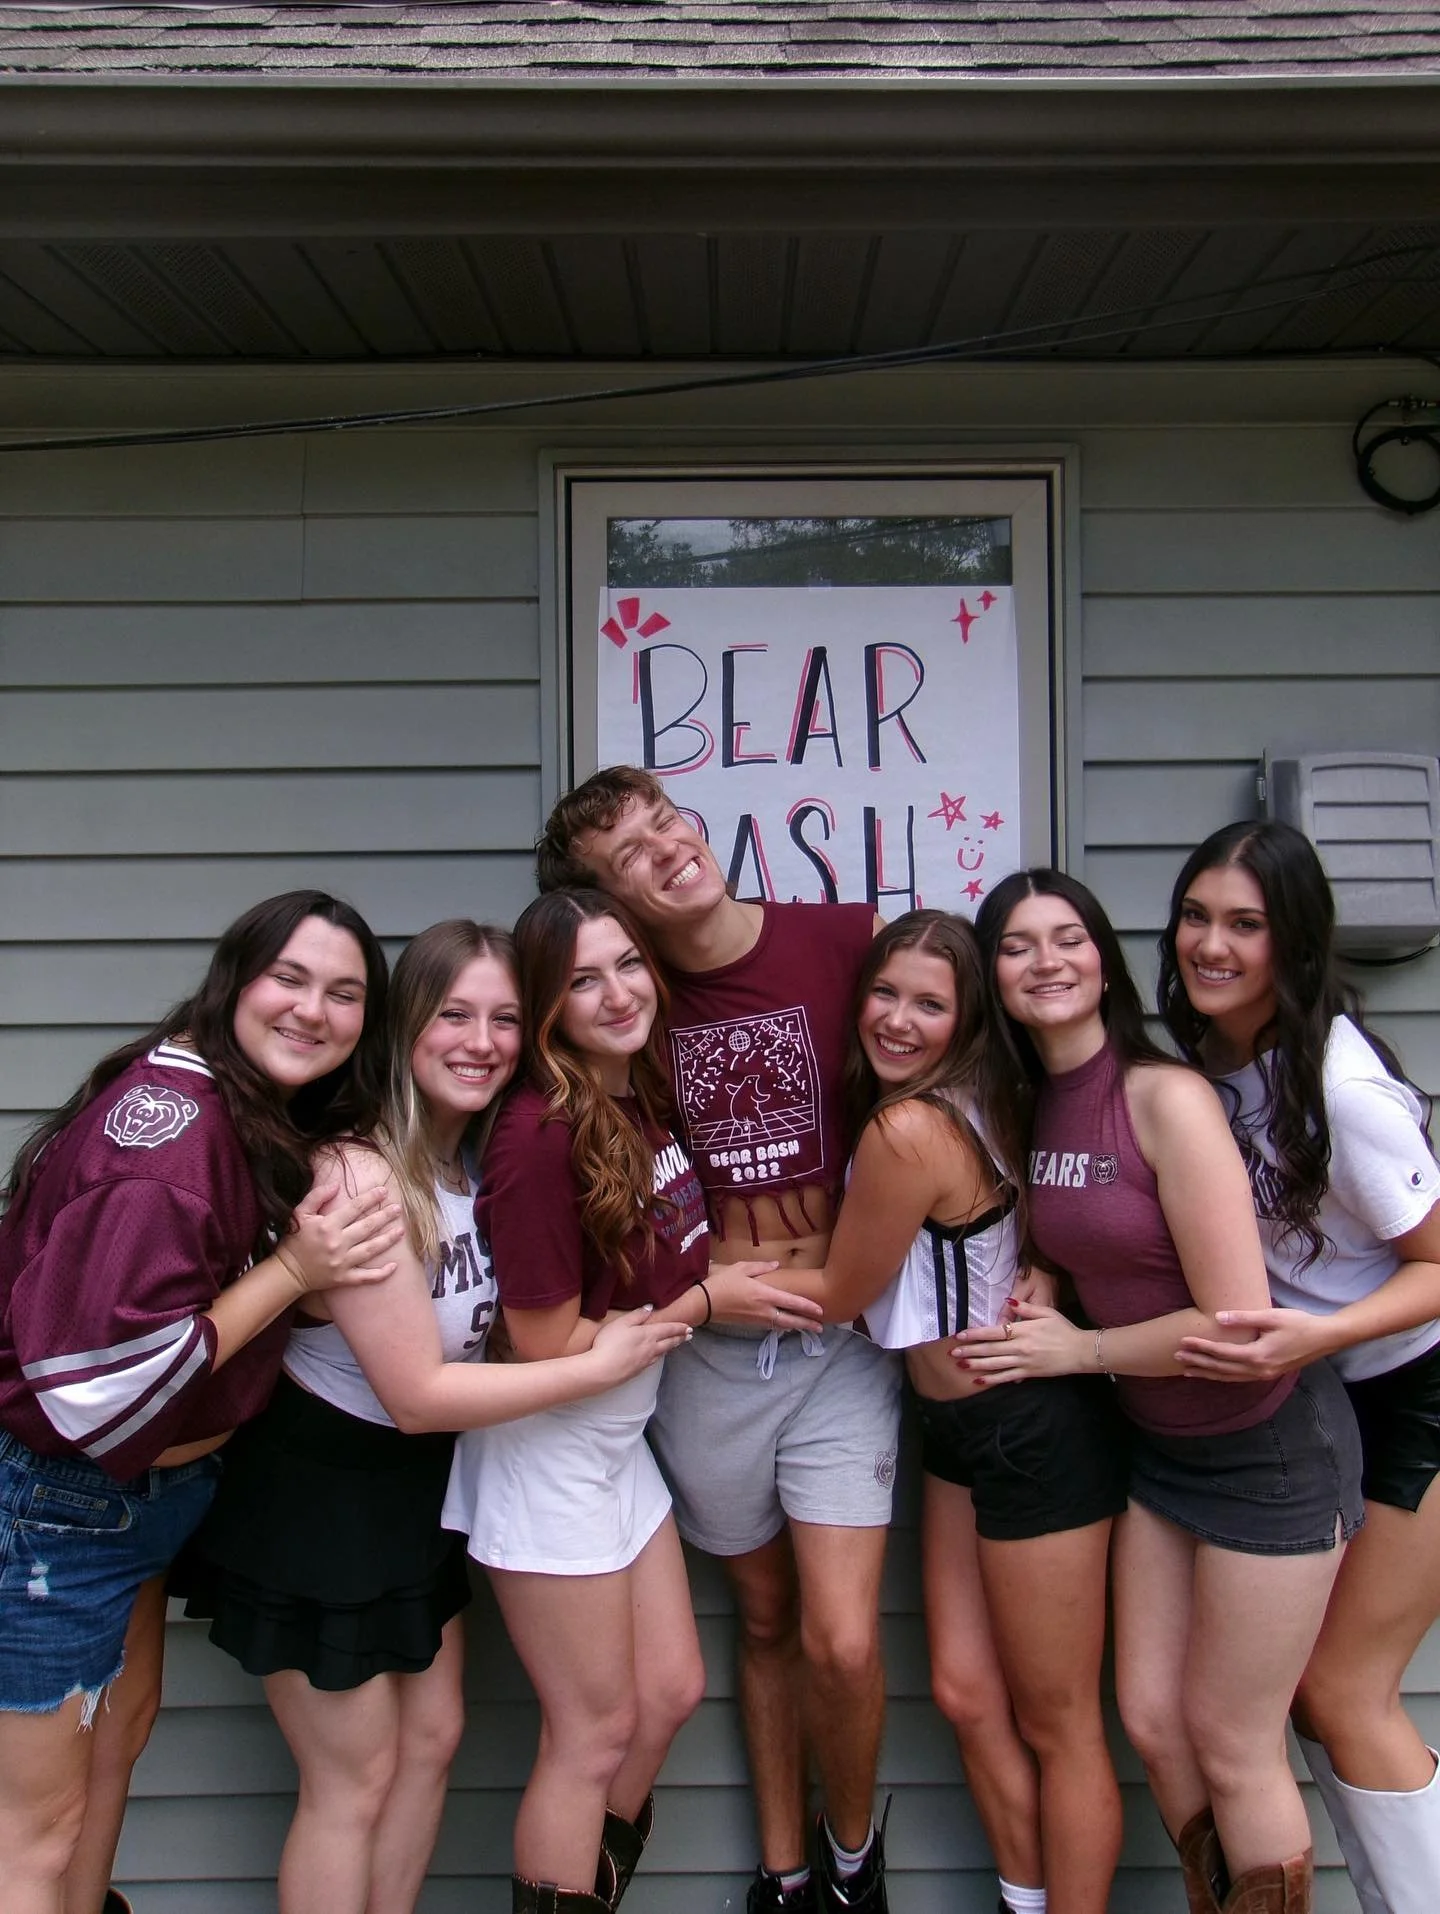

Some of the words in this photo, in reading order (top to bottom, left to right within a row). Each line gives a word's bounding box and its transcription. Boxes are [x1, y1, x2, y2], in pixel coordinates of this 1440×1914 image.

[633, 642, 928, 776] BEAR
[677, 797, 924, 909] ASH
[709, 1149, 752, 1168] BEAR
[756, 1139, 800, 1161] BASH
[731, 1161, 781, 1183] 2022
